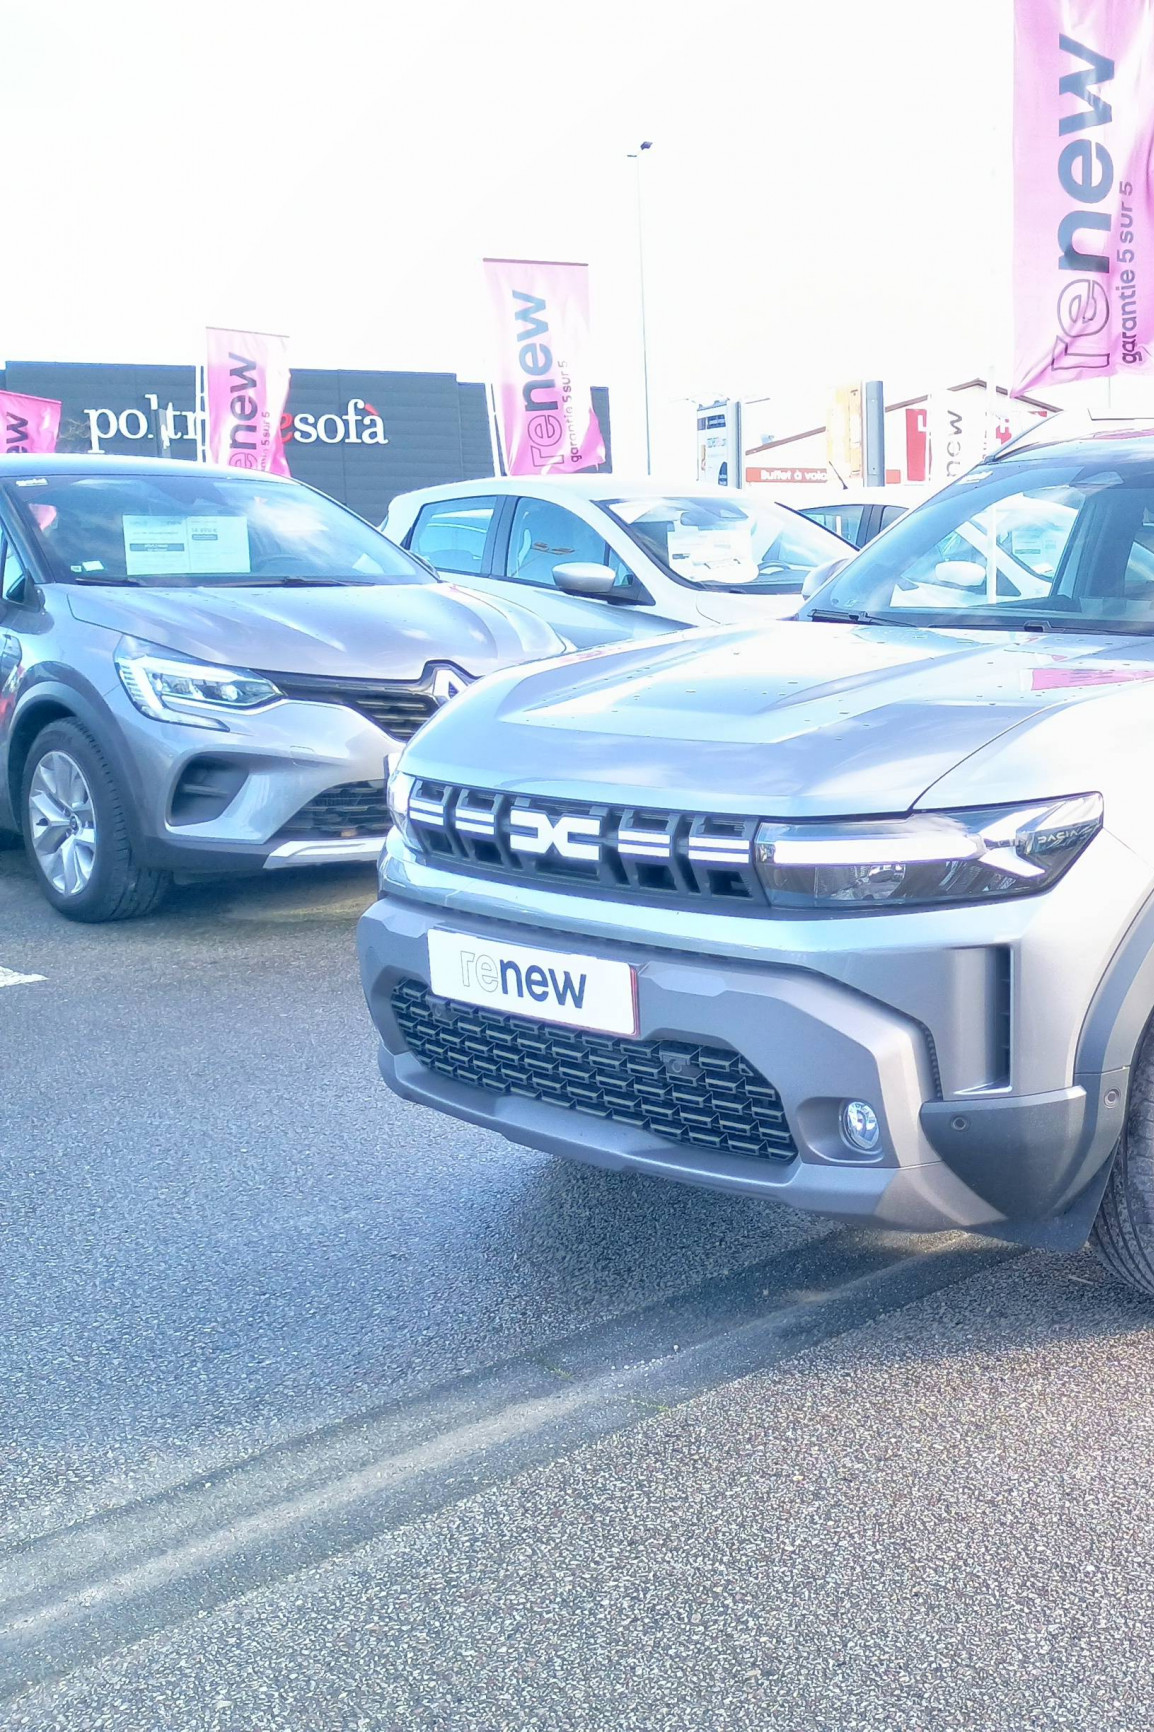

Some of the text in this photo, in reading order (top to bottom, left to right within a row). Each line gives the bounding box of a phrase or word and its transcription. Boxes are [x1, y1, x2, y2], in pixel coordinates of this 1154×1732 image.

[1051, 32, 1115, 372] renew
[1115, 180, 1142, 364] garantie 5 sur 5
[228, 352, 258, 470] enew
[512, 289, 564, 468] renew
[557, 360, 582, 463] garantie 5 sur 5
[760, 469, 827, 481] Buffet à volo
[947, 409, 963, 477] new
[1037, 830, 1078, 844] DACIA
[460, 950, 587, 1009] renew
